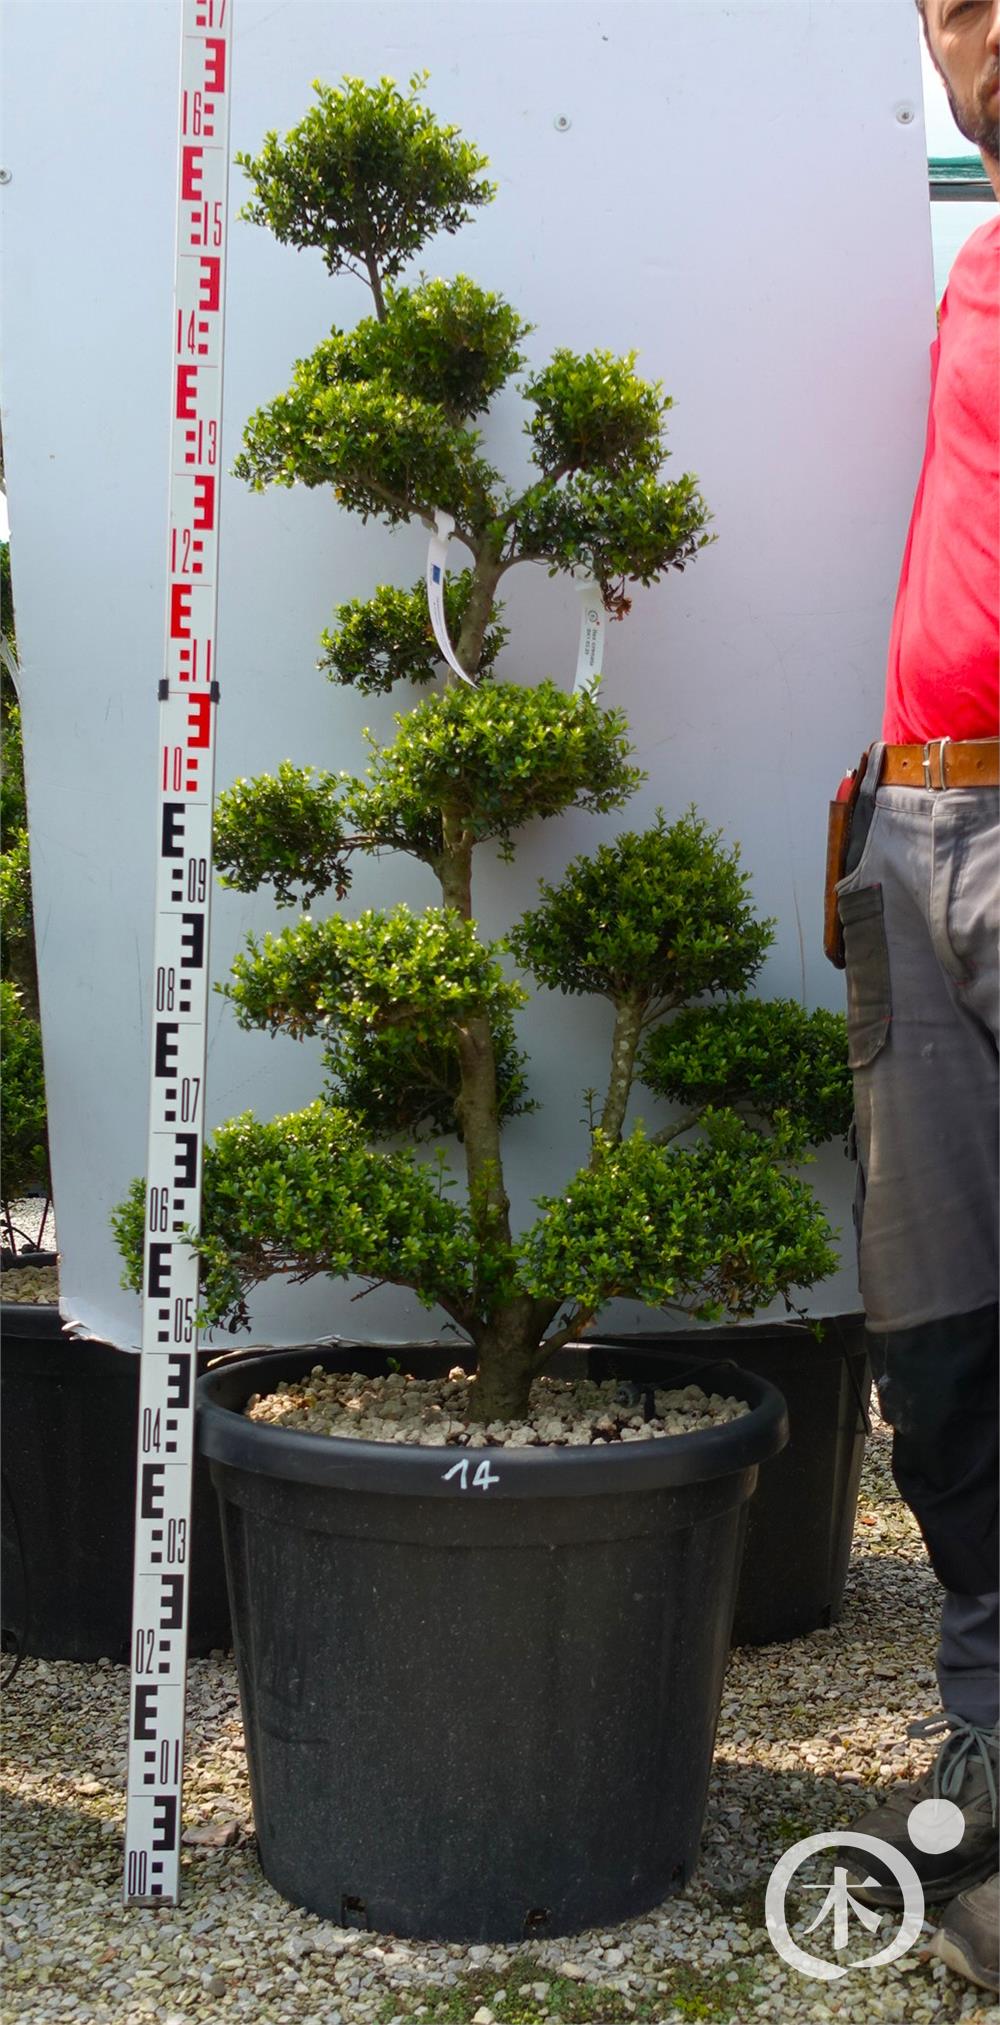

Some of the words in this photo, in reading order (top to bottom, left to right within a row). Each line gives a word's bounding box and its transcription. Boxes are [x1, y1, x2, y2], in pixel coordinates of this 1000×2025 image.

[183, 90, 201, 136] 16
[203, 201, 222, 246] 15
[177, 309, 195, 355] 14
[198, 419, 217, 465] 13
[171, 528, 191, 573] 12
[192, 639, 211, 682] 11
[163, 746, 183, 791] 10
[188, 858, 207, 903] 09
[156, 967, 175, 1012] 08
[181, 1077, 200, 1123] 07
[150, 1187, 169, 1232] 06
[174, 1297, 193, 1343] 05
[143, 1407, 161, 1453] 04
[441, 1458, 500, 1491] 14
[167, 1518, 186, 1563] 03
[135, 1629, 155, 1674] 02
[160, 1739, 179, 1785] 01
[128, 1850, 147, 1896] 00
